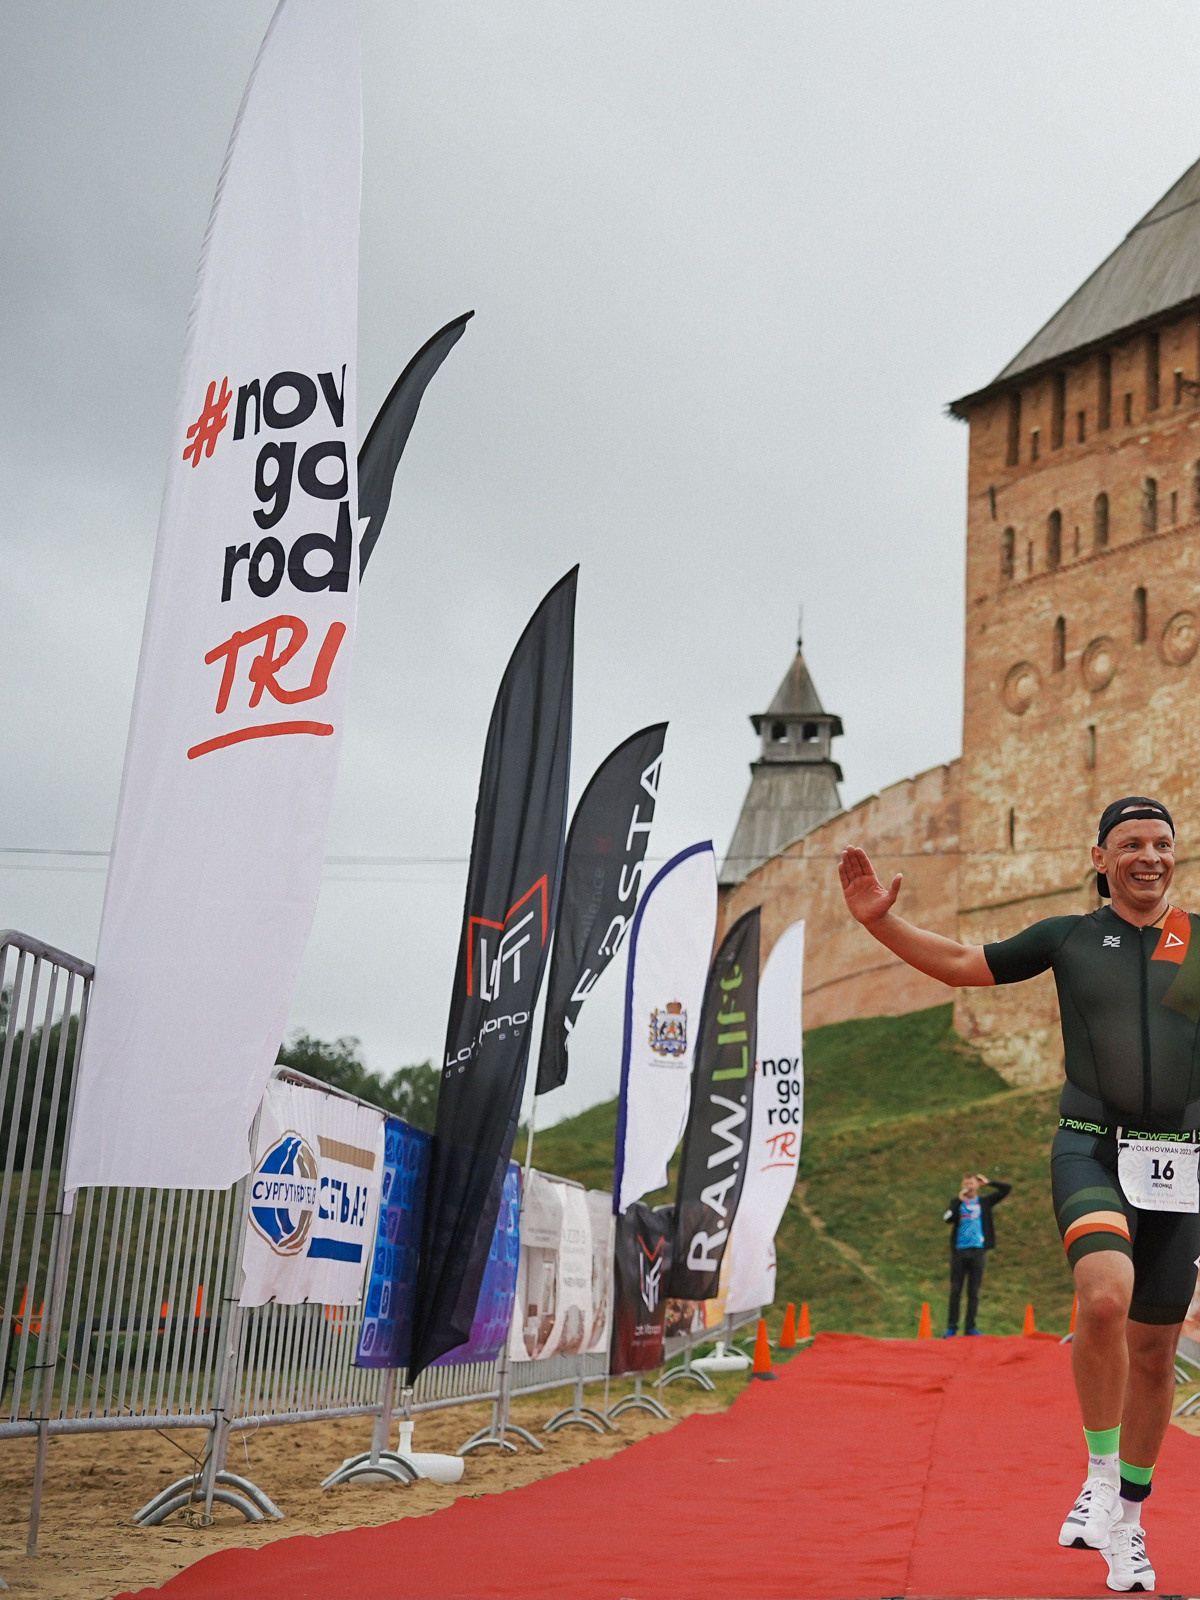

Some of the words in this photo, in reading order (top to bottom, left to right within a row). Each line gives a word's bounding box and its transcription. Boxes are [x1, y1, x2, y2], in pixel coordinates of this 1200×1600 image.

[182, 364, 347, 468] #nov
[253, 441, 348, 529] go
[221, 501, 352, 602] rod
[204, 615, 347, 714] TRI
[777, 1080, 800, 1104] go
[1127, 1130, 1191, 1142] POWERUP
[1131, 1145, 1179, 1154] VOLKHOVMAN
[1180, 1148, 1192, 1156] 2023
[687, 1094, 748, 1272] R.A.W.
[1151, 1159, 1175, 1181] 16
[1152, 1182, 1173, 1190] ЛЕОНИД
